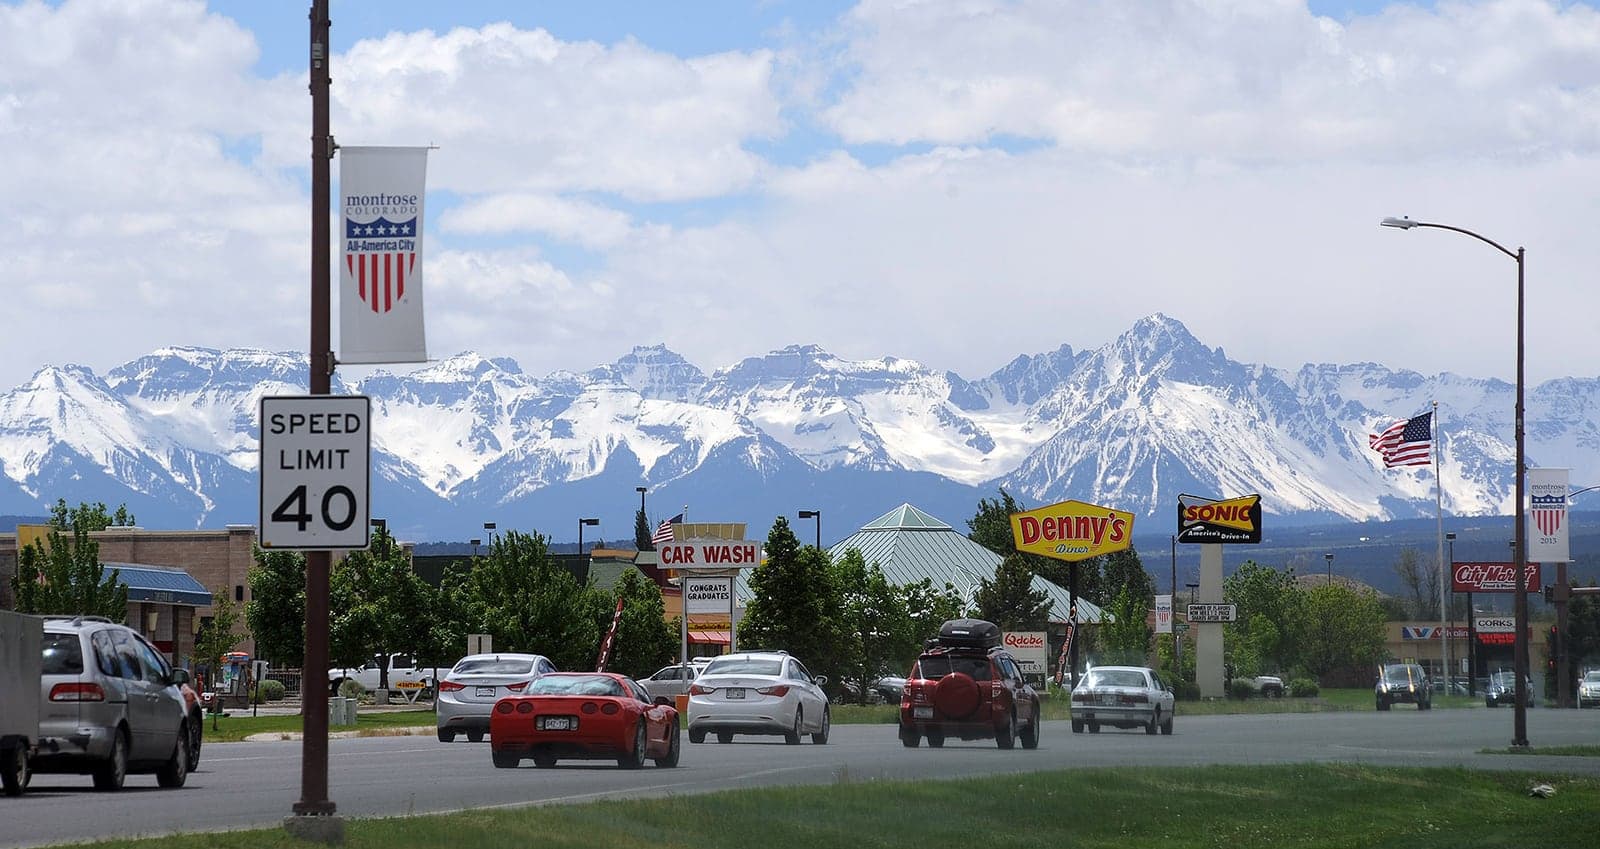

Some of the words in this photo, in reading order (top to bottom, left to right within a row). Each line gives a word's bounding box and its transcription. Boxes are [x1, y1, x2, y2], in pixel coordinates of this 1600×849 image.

[346, 193, 417, 206] montrose
[346, 206, 417, 215] COLORADO
[347, 240, 397, 251] All-America
[398, 239, 415, 251] City
[270, 413, 361, 434] SPEED
[280, 449, 350, 470] LIMIT
[271, 485, 357, 531] 40
[1186, 504, 1251, 522] SONIC
[1018, 512, 1127, 545] Denny's
[661, 545, 695, 564] CAR
[703, 545, 755, 564] WASH
[1055, 543, 1089, 554] Diner
[690, 584, 727, 593] CONGRATS
[688, 592, 730, 601] GRADUATES
[1005, 633, 1043, 648] Qdoba
